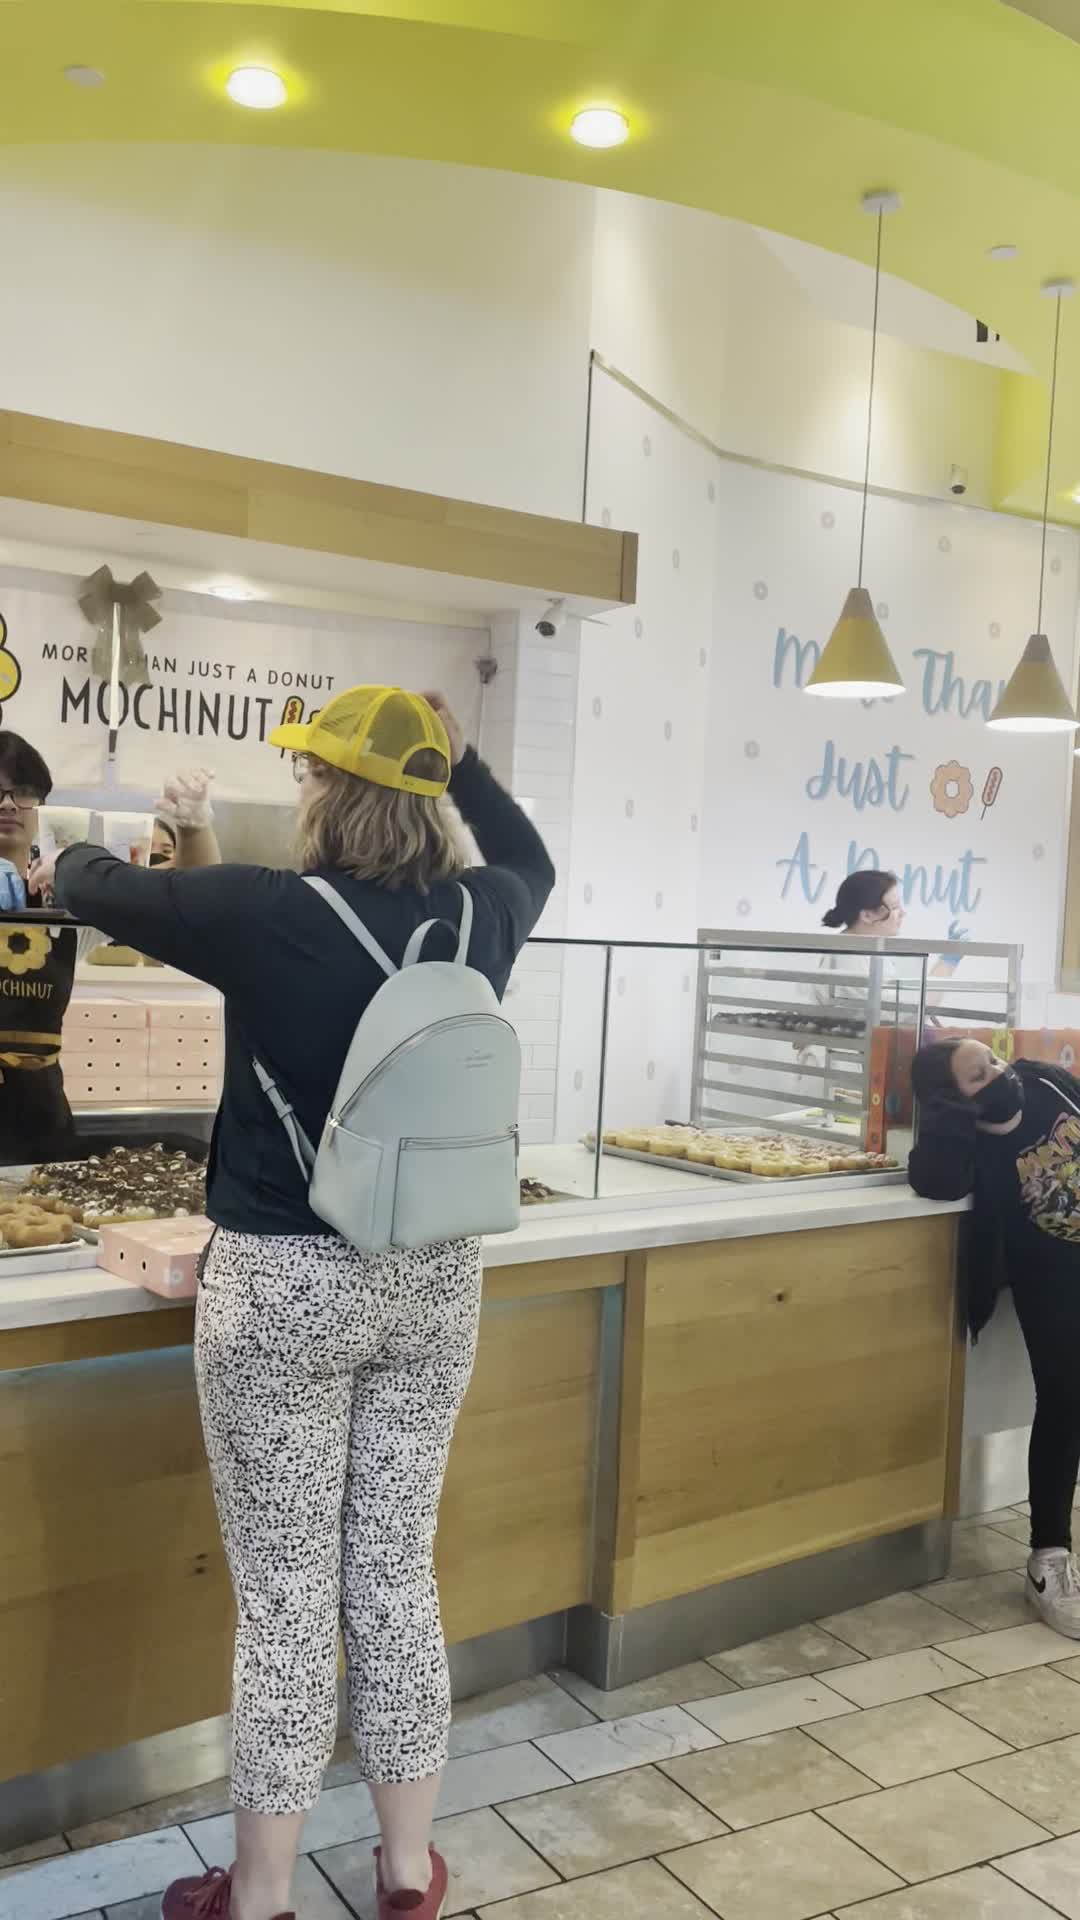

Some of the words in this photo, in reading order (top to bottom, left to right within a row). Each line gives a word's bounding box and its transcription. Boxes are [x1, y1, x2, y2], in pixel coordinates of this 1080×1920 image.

[42, 643, 88, 663] MOR
[187, 660, 236, 681] JUST
[247, 668, 257, 684] A
[268, 670, 335, 691] DONUT
[912, 648, 1005, 721] Tha
[60, 676, 273, 742] MOCHINUT
[806, 740, 916, 812] Just
[776, 831, 828, 904] A
[0, 979, 54, 999] CHINUT
